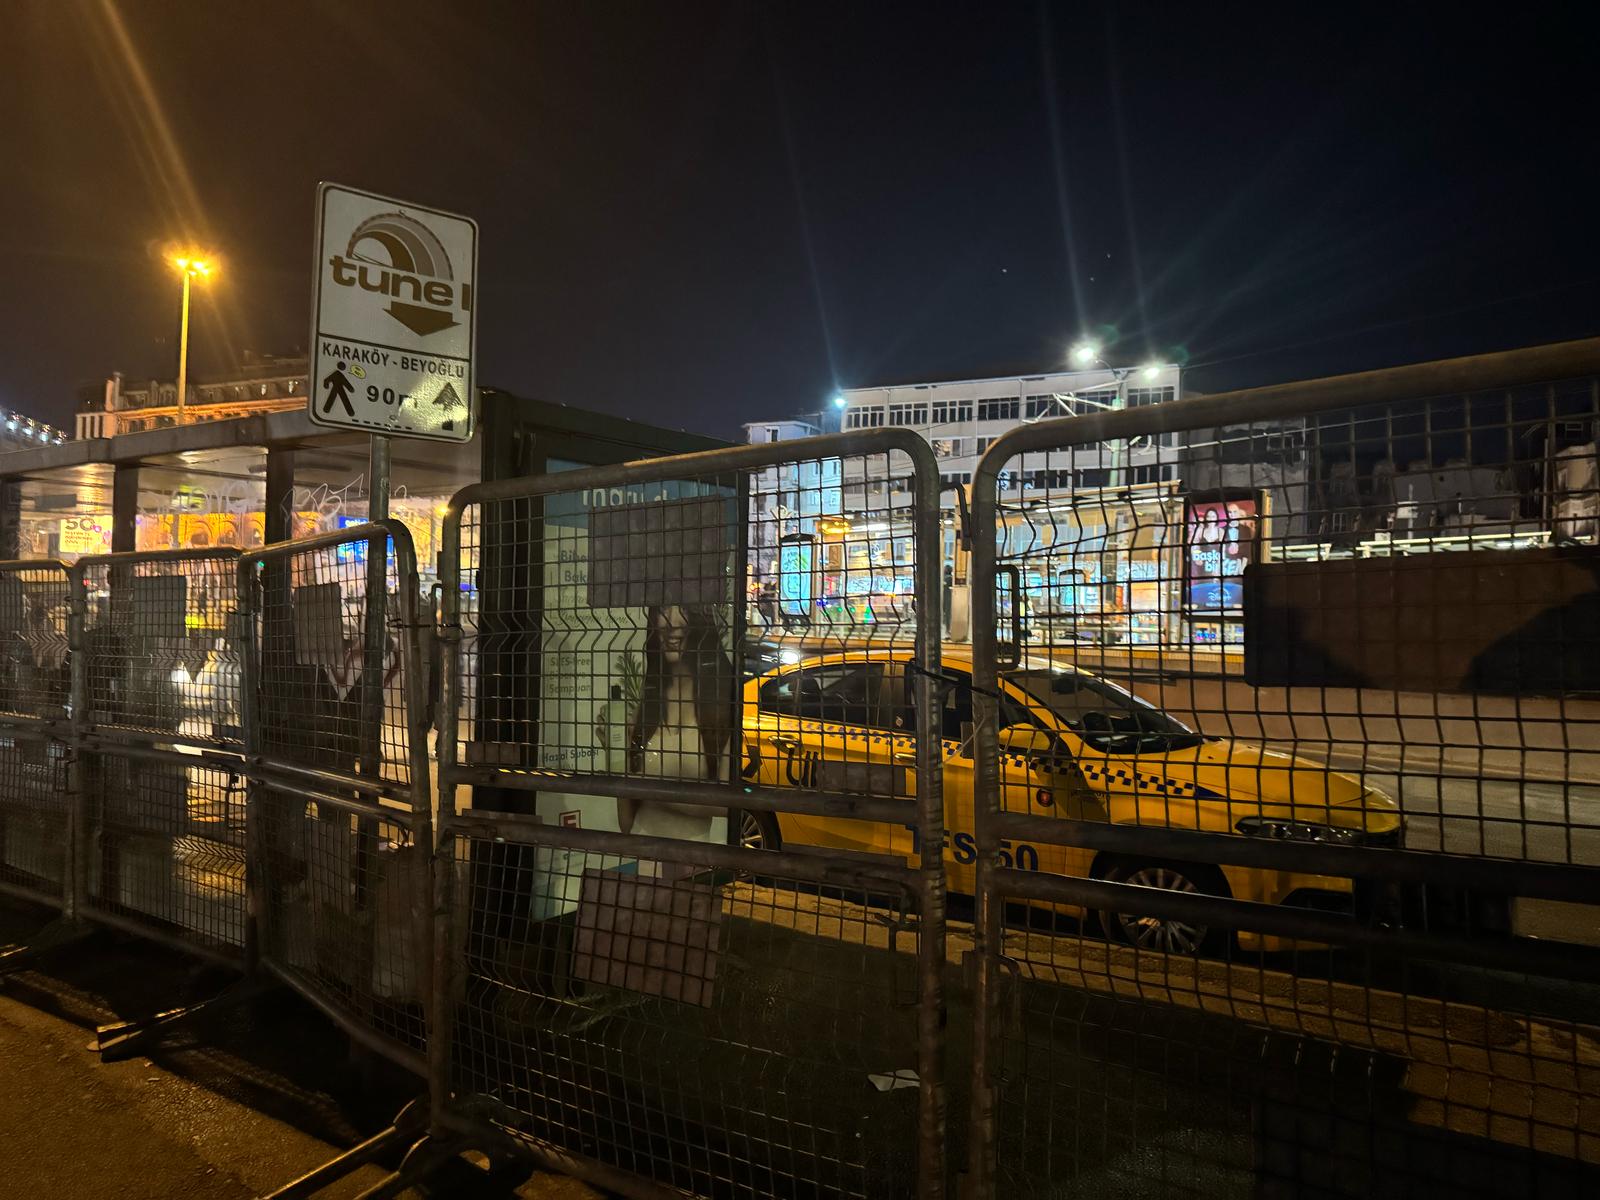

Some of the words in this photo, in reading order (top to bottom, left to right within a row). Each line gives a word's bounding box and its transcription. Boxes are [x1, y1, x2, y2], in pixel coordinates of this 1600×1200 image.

[329, 255, 470, 311] tunel
[323, 342, 390, 367] KARAKÖY
[401, 356, 465, 378] BEYOĞLU
